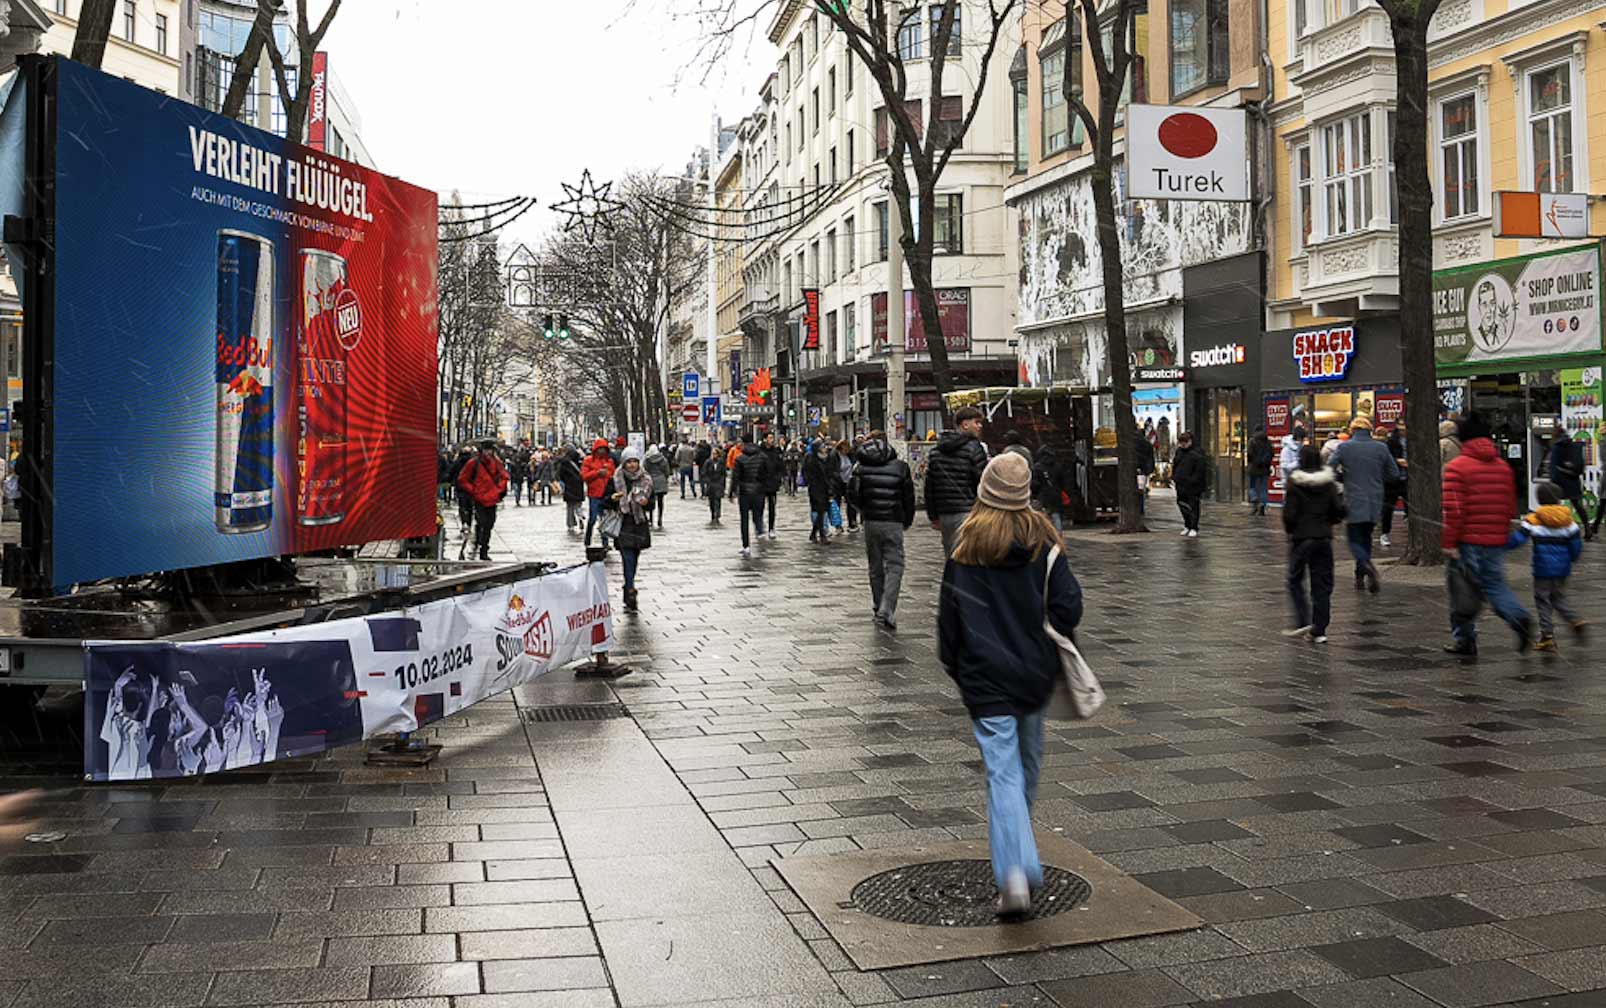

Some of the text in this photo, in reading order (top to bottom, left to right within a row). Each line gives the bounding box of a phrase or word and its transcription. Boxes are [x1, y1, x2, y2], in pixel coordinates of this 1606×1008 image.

[188, 125, 374, 223] VERLEIHT FLÜÜÜGEL.
[1152, 168, 1225, 192] Turek
[191, 186, 217, 204] AUCH
[217, 192, 232, 209] MIT
[232, 195, 250, 212] DEM
[251, 201, 298, 225] GESCHMACK
[298, 214, 315, 229] VON
[1528, 271, 1593, 298] SHOP ONLINE
[338, 304, 358, 335] NEU
[1190, 344, 1236, 368] swatch
[1295, 330, 1353, 356] SNACK
[1140, 369, 1178, 379] swatch
[1301, 353, 1345, 377] SHOP
[395, 643, 473, 690] 10.02.2024
